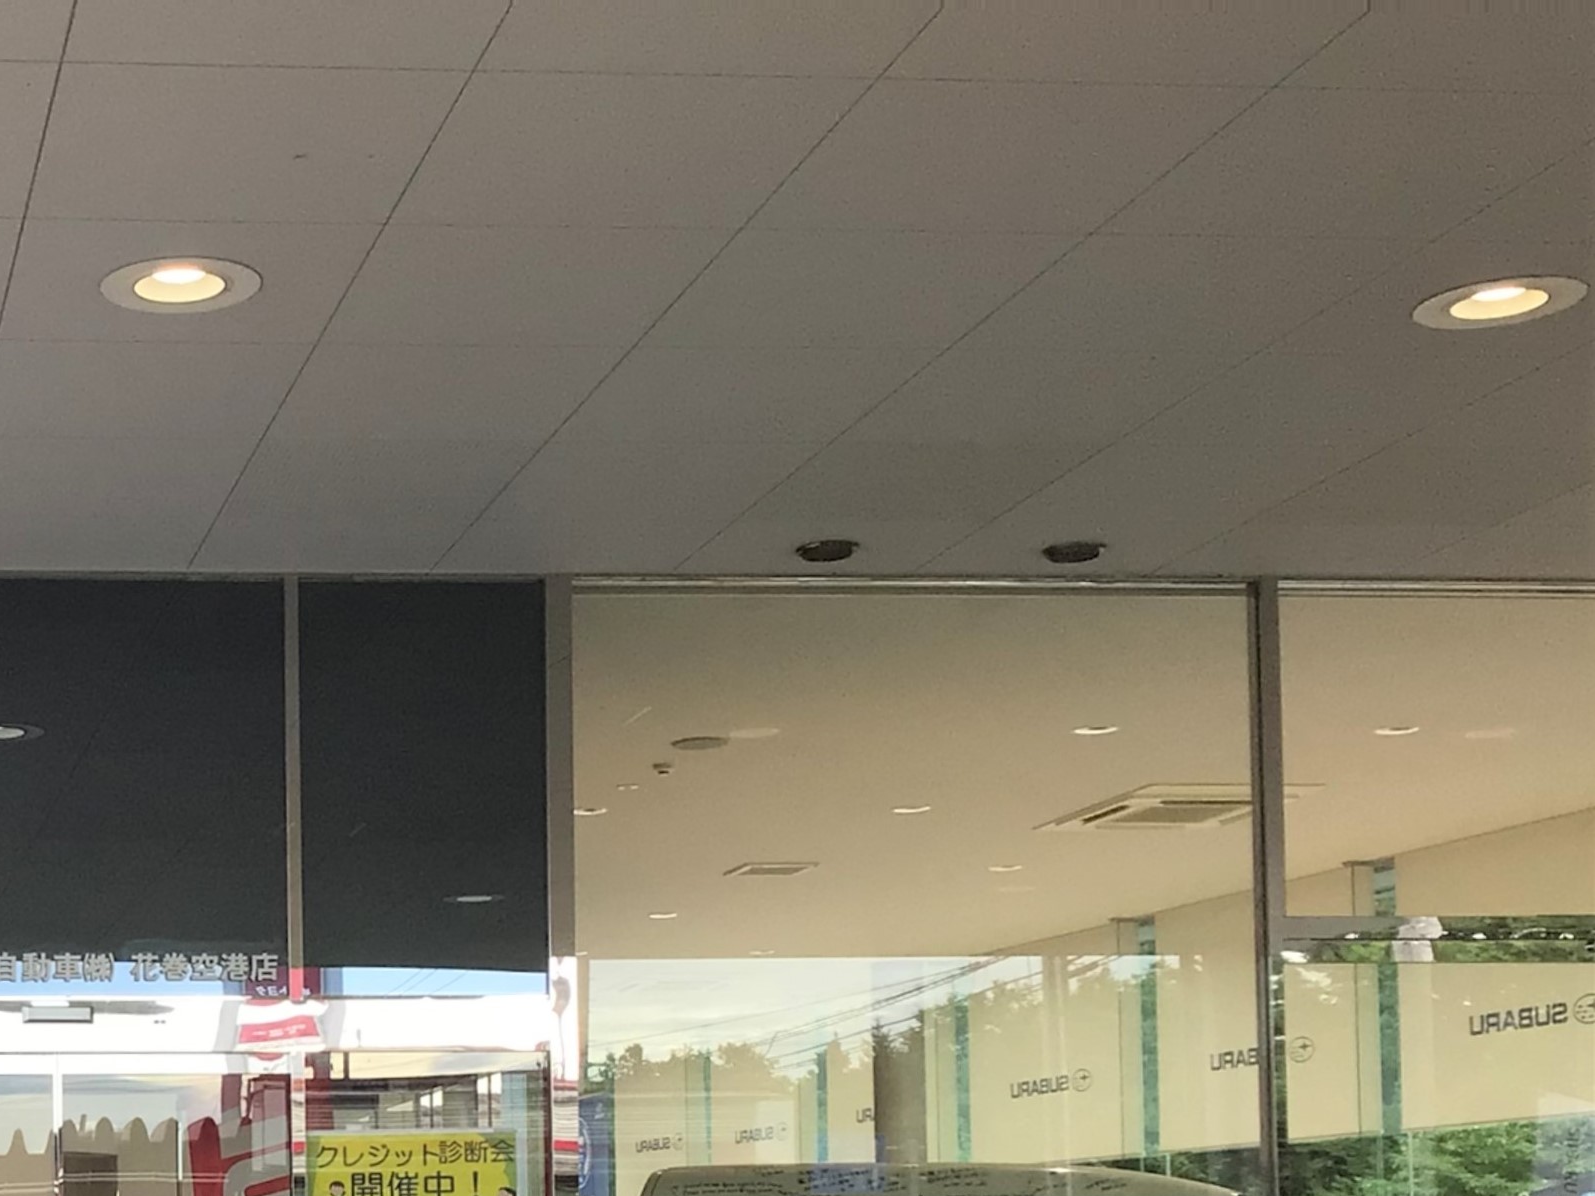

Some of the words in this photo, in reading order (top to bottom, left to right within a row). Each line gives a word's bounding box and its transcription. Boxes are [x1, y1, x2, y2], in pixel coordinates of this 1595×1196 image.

[130, 952, 279, 982] 花巻空港店
[316, 1140, 516, 1168] クレジット診断会
